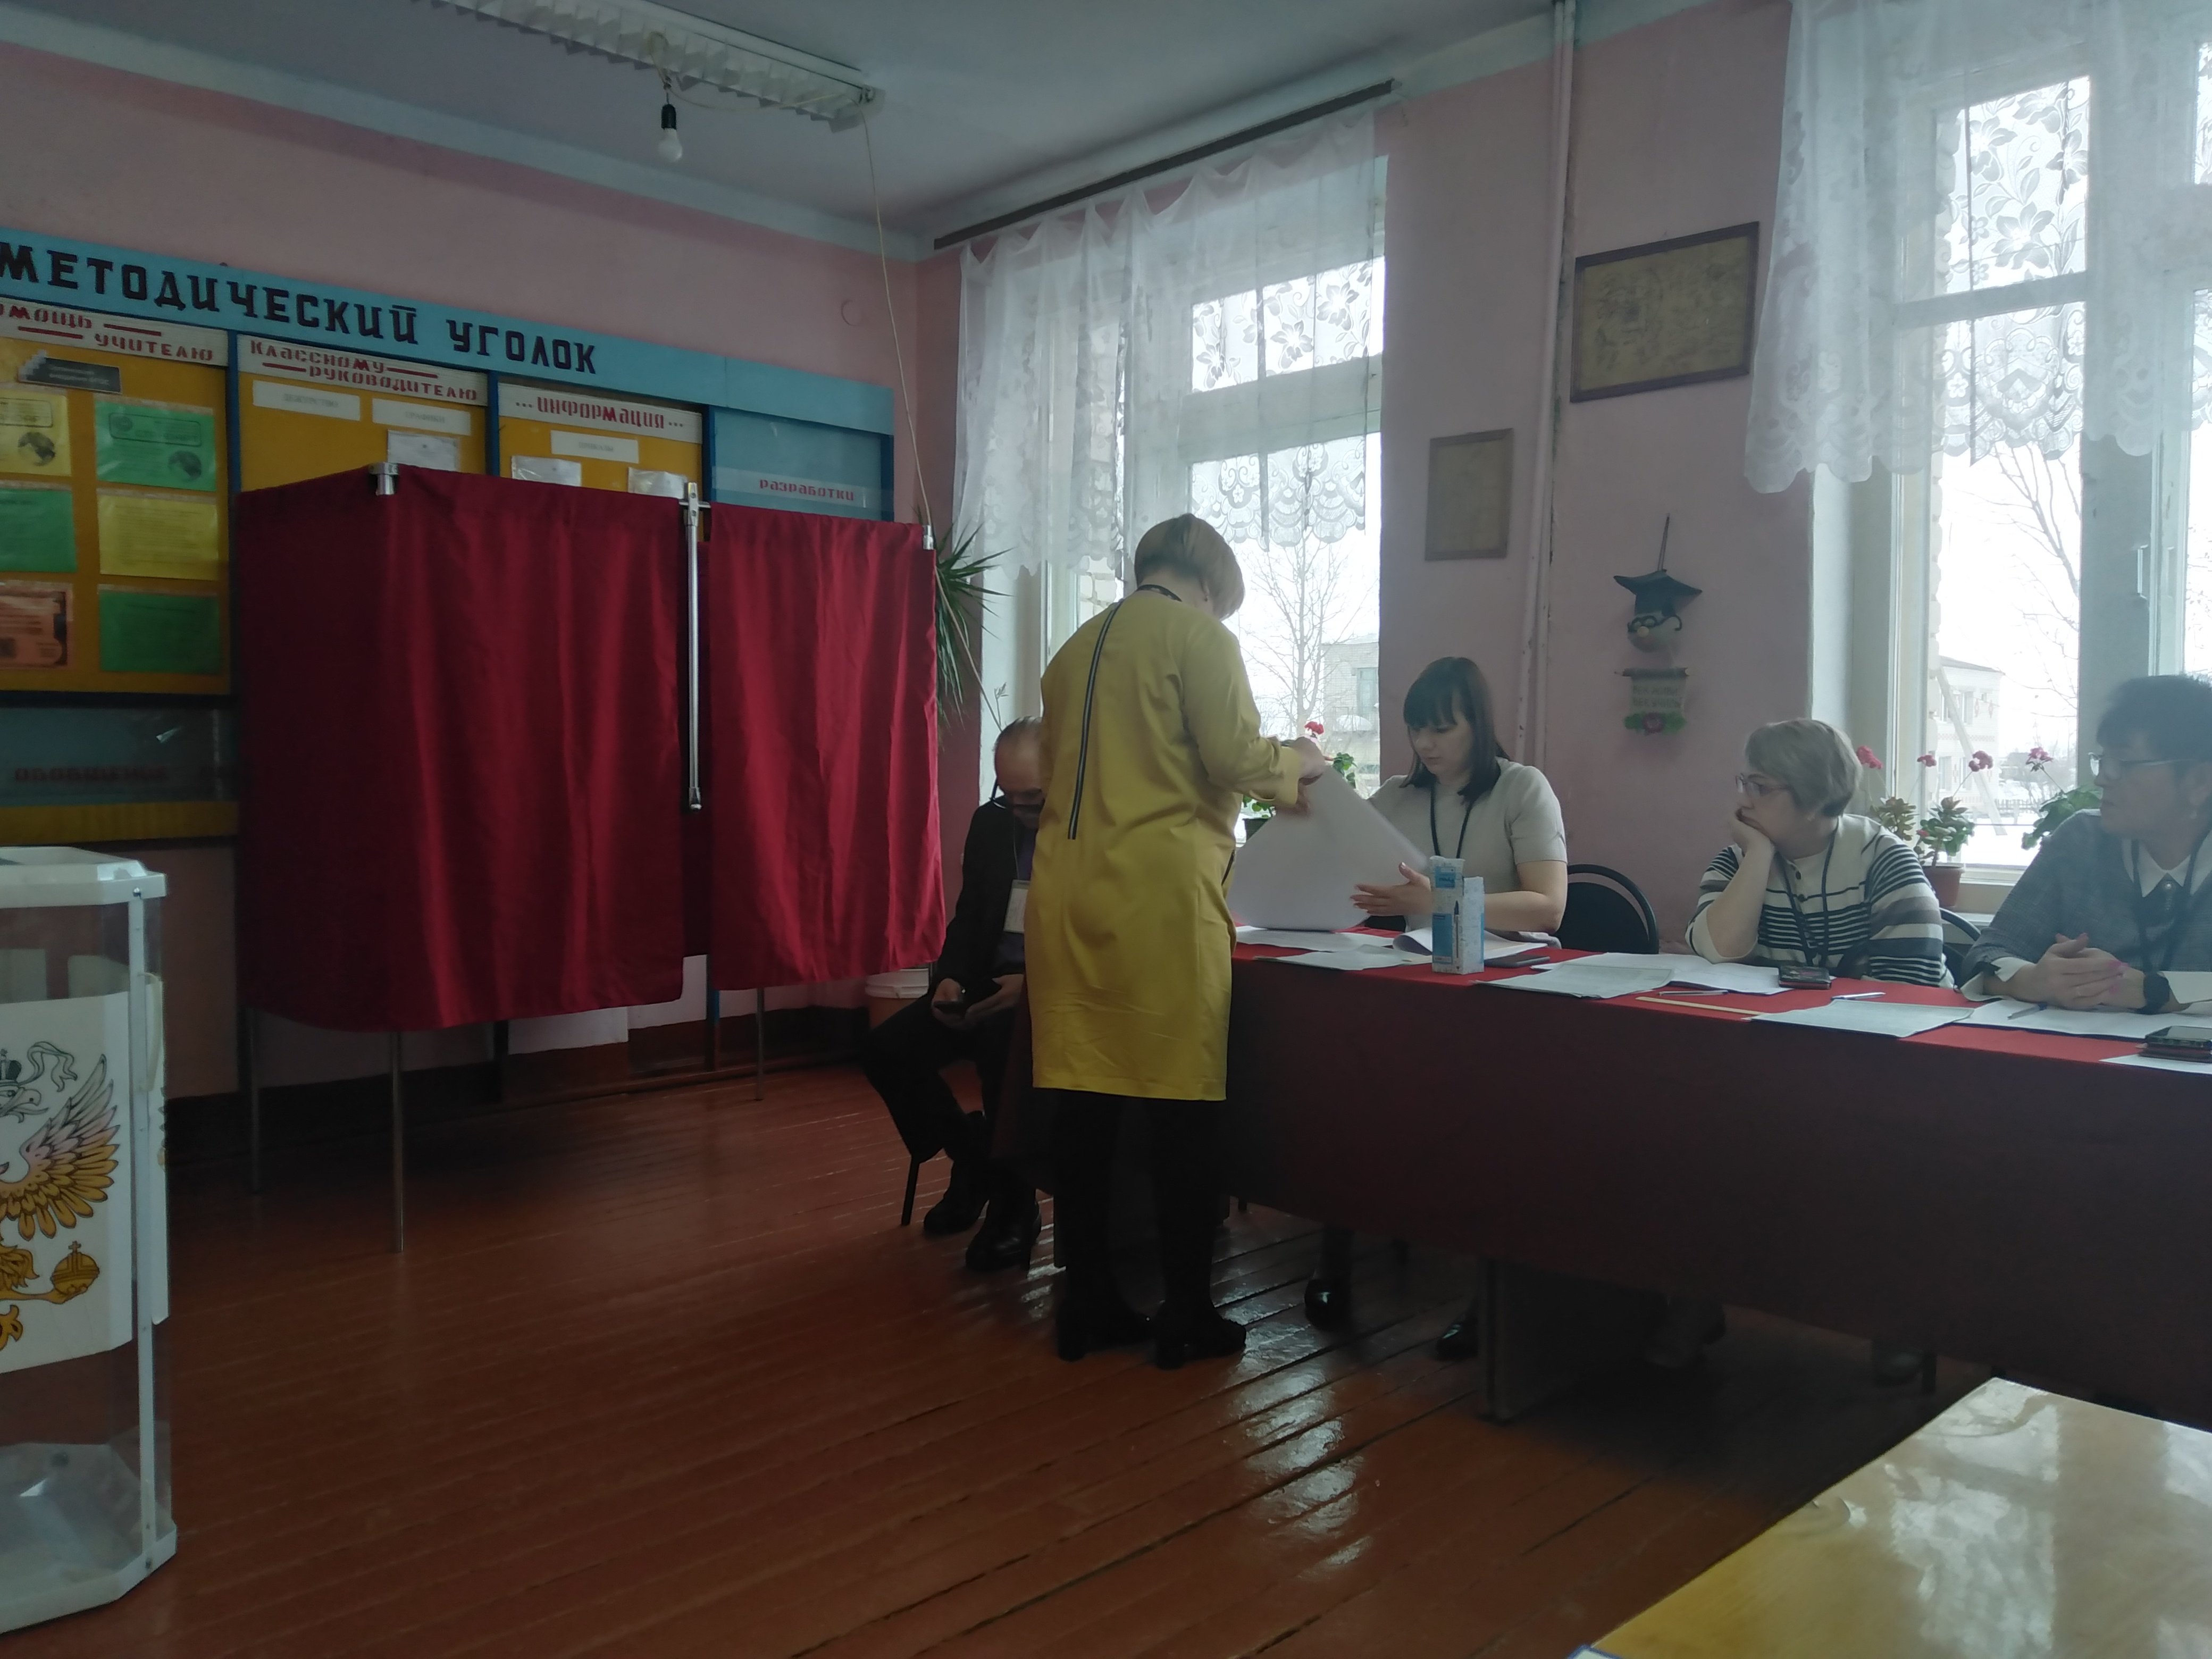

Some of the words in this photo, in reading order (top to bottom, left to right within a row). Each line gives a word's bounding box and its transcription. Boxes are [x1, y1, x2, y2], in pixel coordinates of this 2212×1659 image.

[0, 241, 418, 345] МЕТОДИЧЕСКИЙ
[446, 320, 596, 374] УГОЛОК
[95, 333, 213, 361] УЧИТЕЛЮ
[250, 340, 384, 372] КЛАССНОМУ
[309, 365, 477, 400] РУКОВОДИТЕЛЮ
